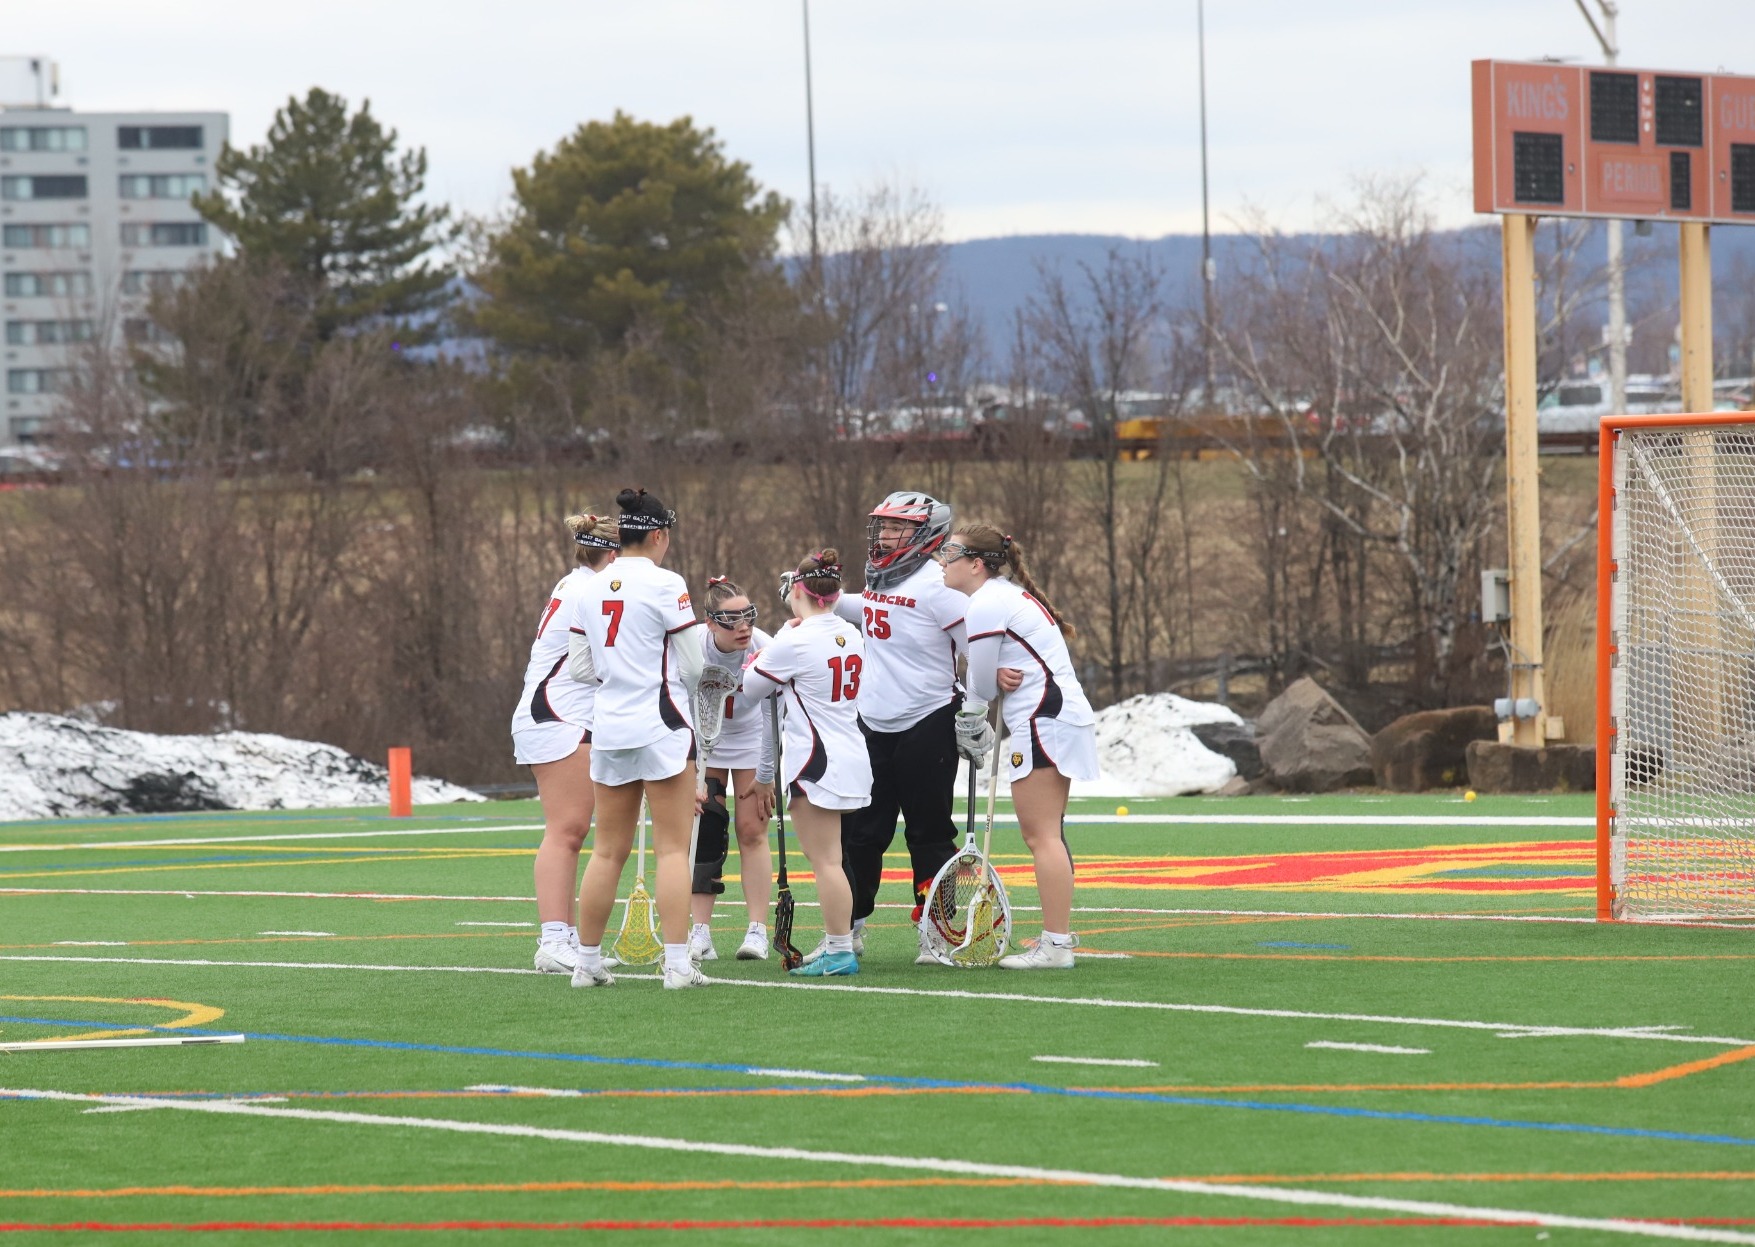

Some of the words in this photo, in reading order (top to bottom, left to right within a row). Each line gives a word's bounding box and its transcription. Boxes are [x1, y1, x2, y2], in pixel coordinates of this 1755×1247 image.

[1506, 73, 1568, 120] KING'S
[1602, 161, 1660, 193] PERIOD
[594, 537, 608, 545] GAIT
[862, 589, 917, 609] NARCHS
[538, 597, 562, 640] 7
[602, 600, 624, 647] 7
[864, 606, 892, 640] 25
[827, 654, 862, 702] 13
